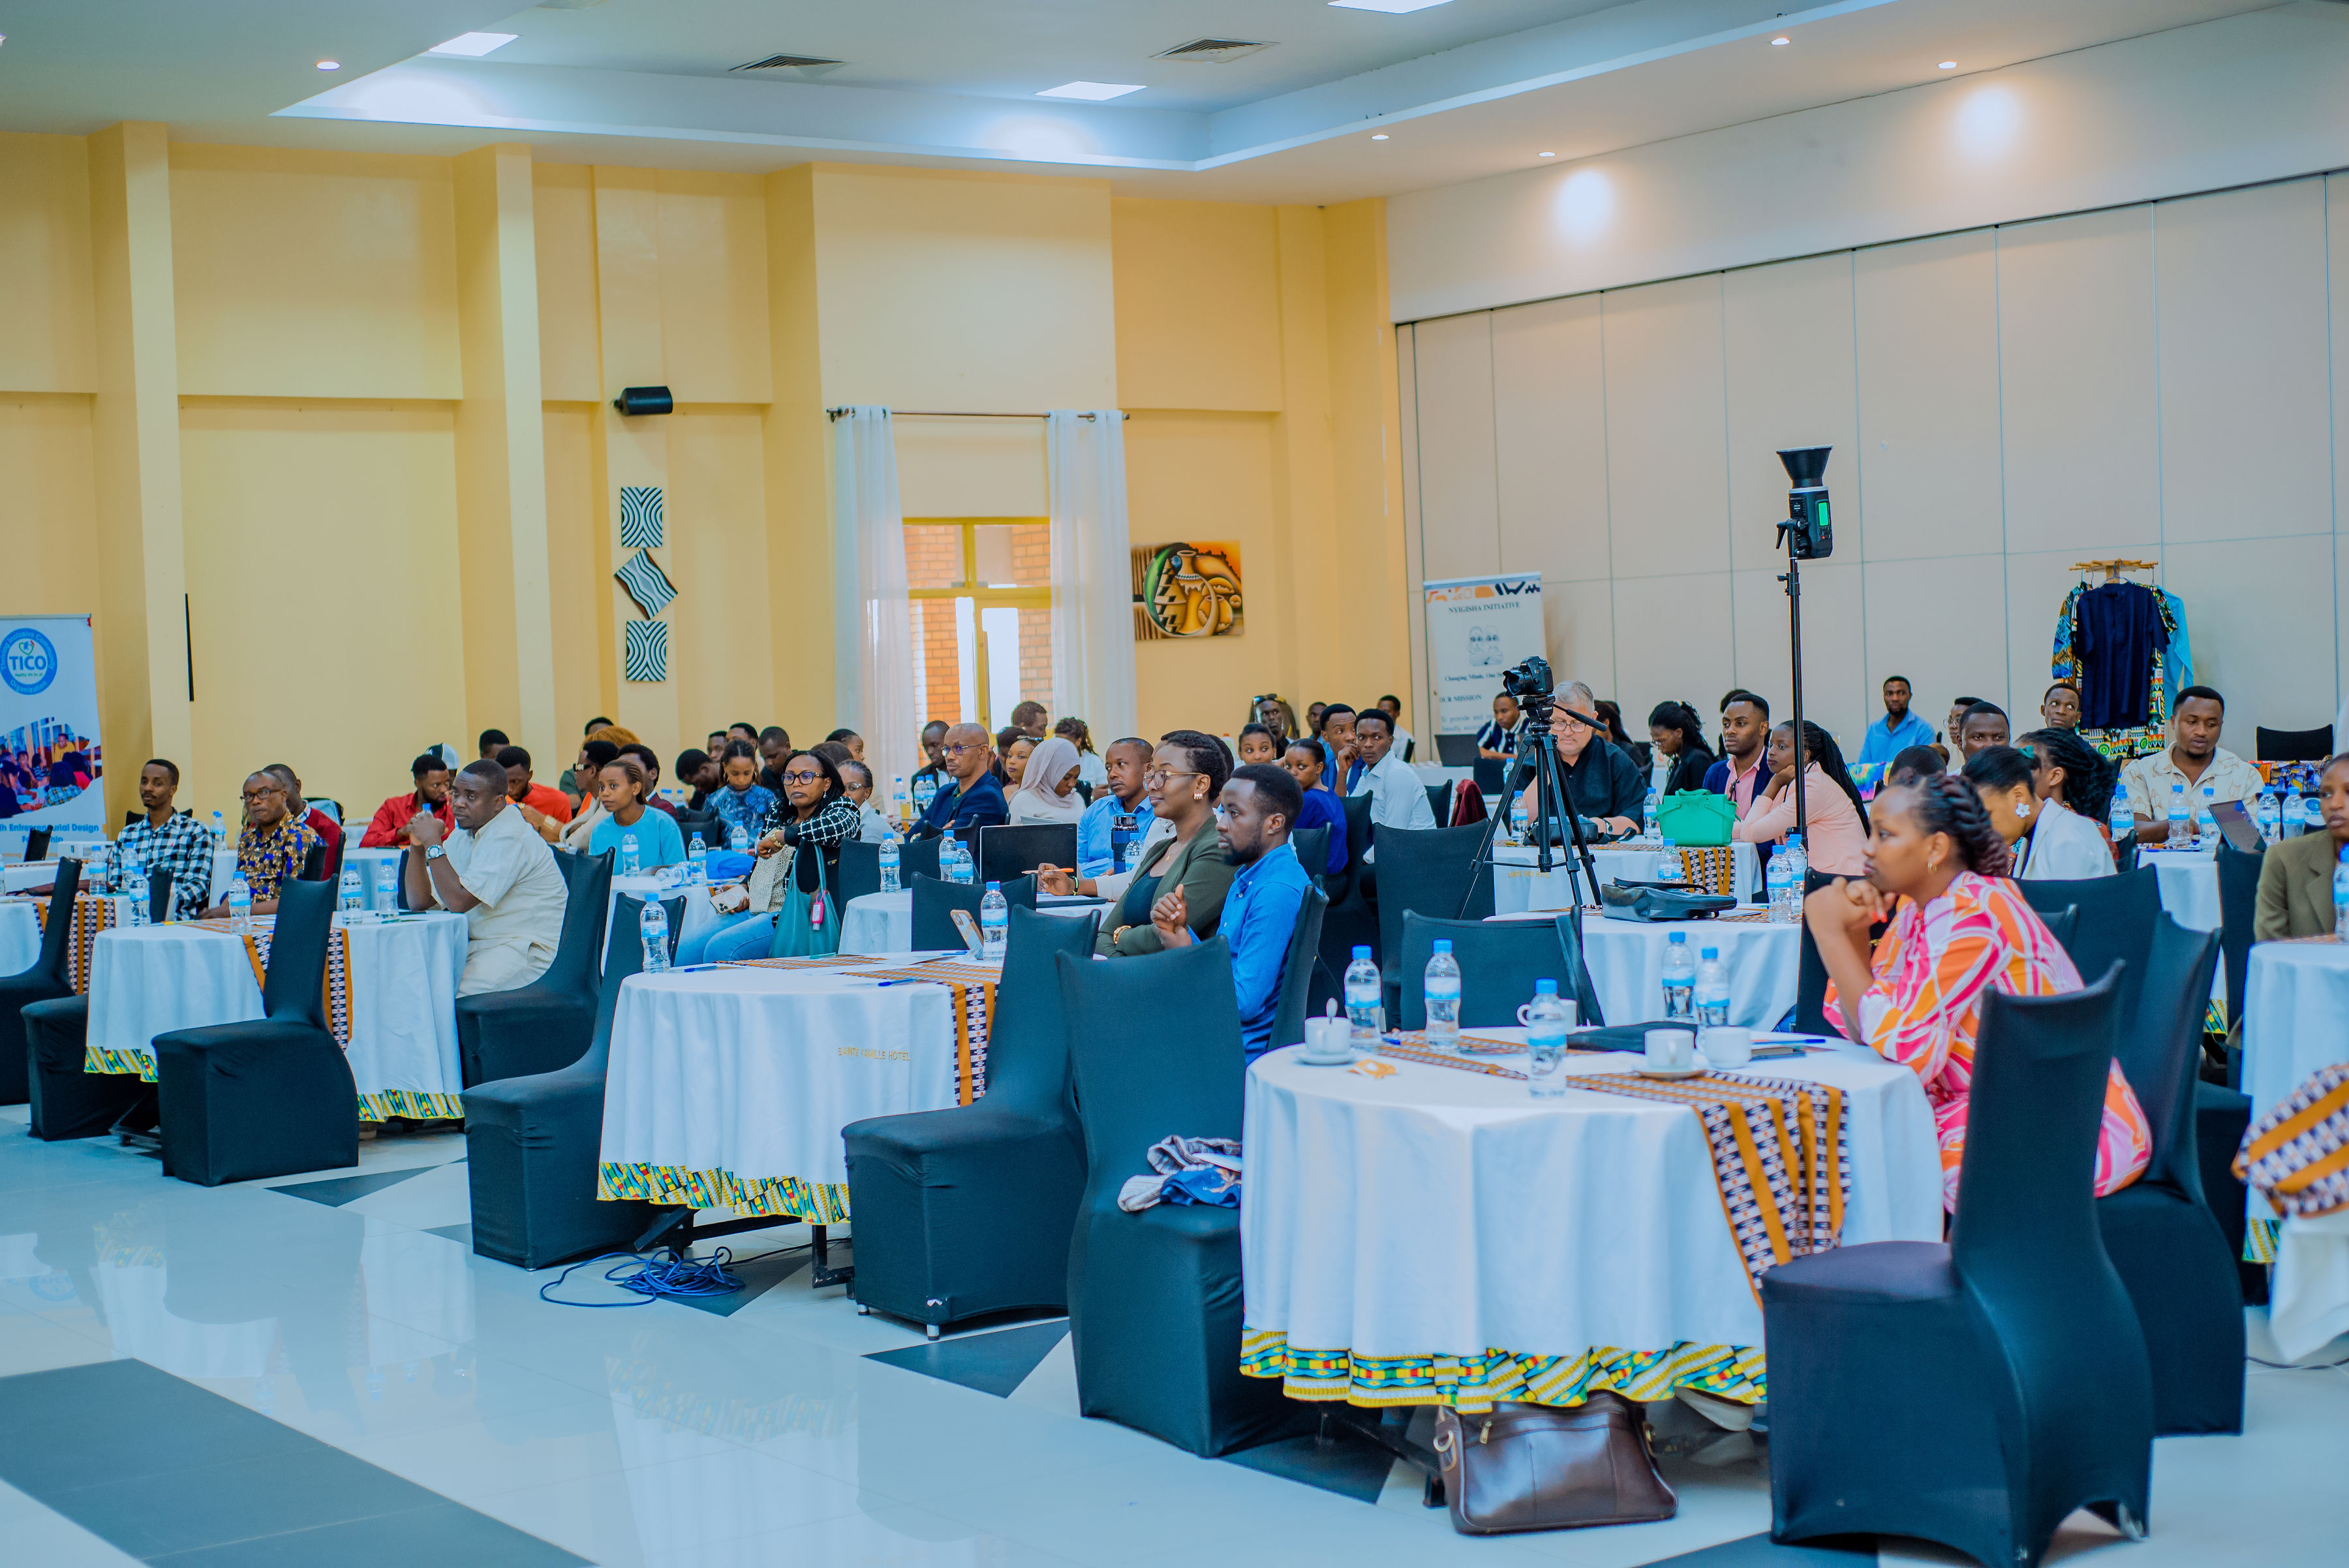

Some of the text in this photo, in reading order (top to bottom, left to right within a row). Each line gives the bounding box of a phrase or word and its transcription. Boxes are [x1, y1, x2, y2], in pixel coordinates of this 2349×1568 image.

[1483, 601, 1520, 611] INITIATIVE
[9, 655, 46, 670] TICO
[10, 679, 47, 693] Organization
[9, 823, 70, 833] Entreprenurial
[72, 823, 99, 833] Design
[837, 1047, 910, 1061] SAINTE FAMILLE HOTEL
